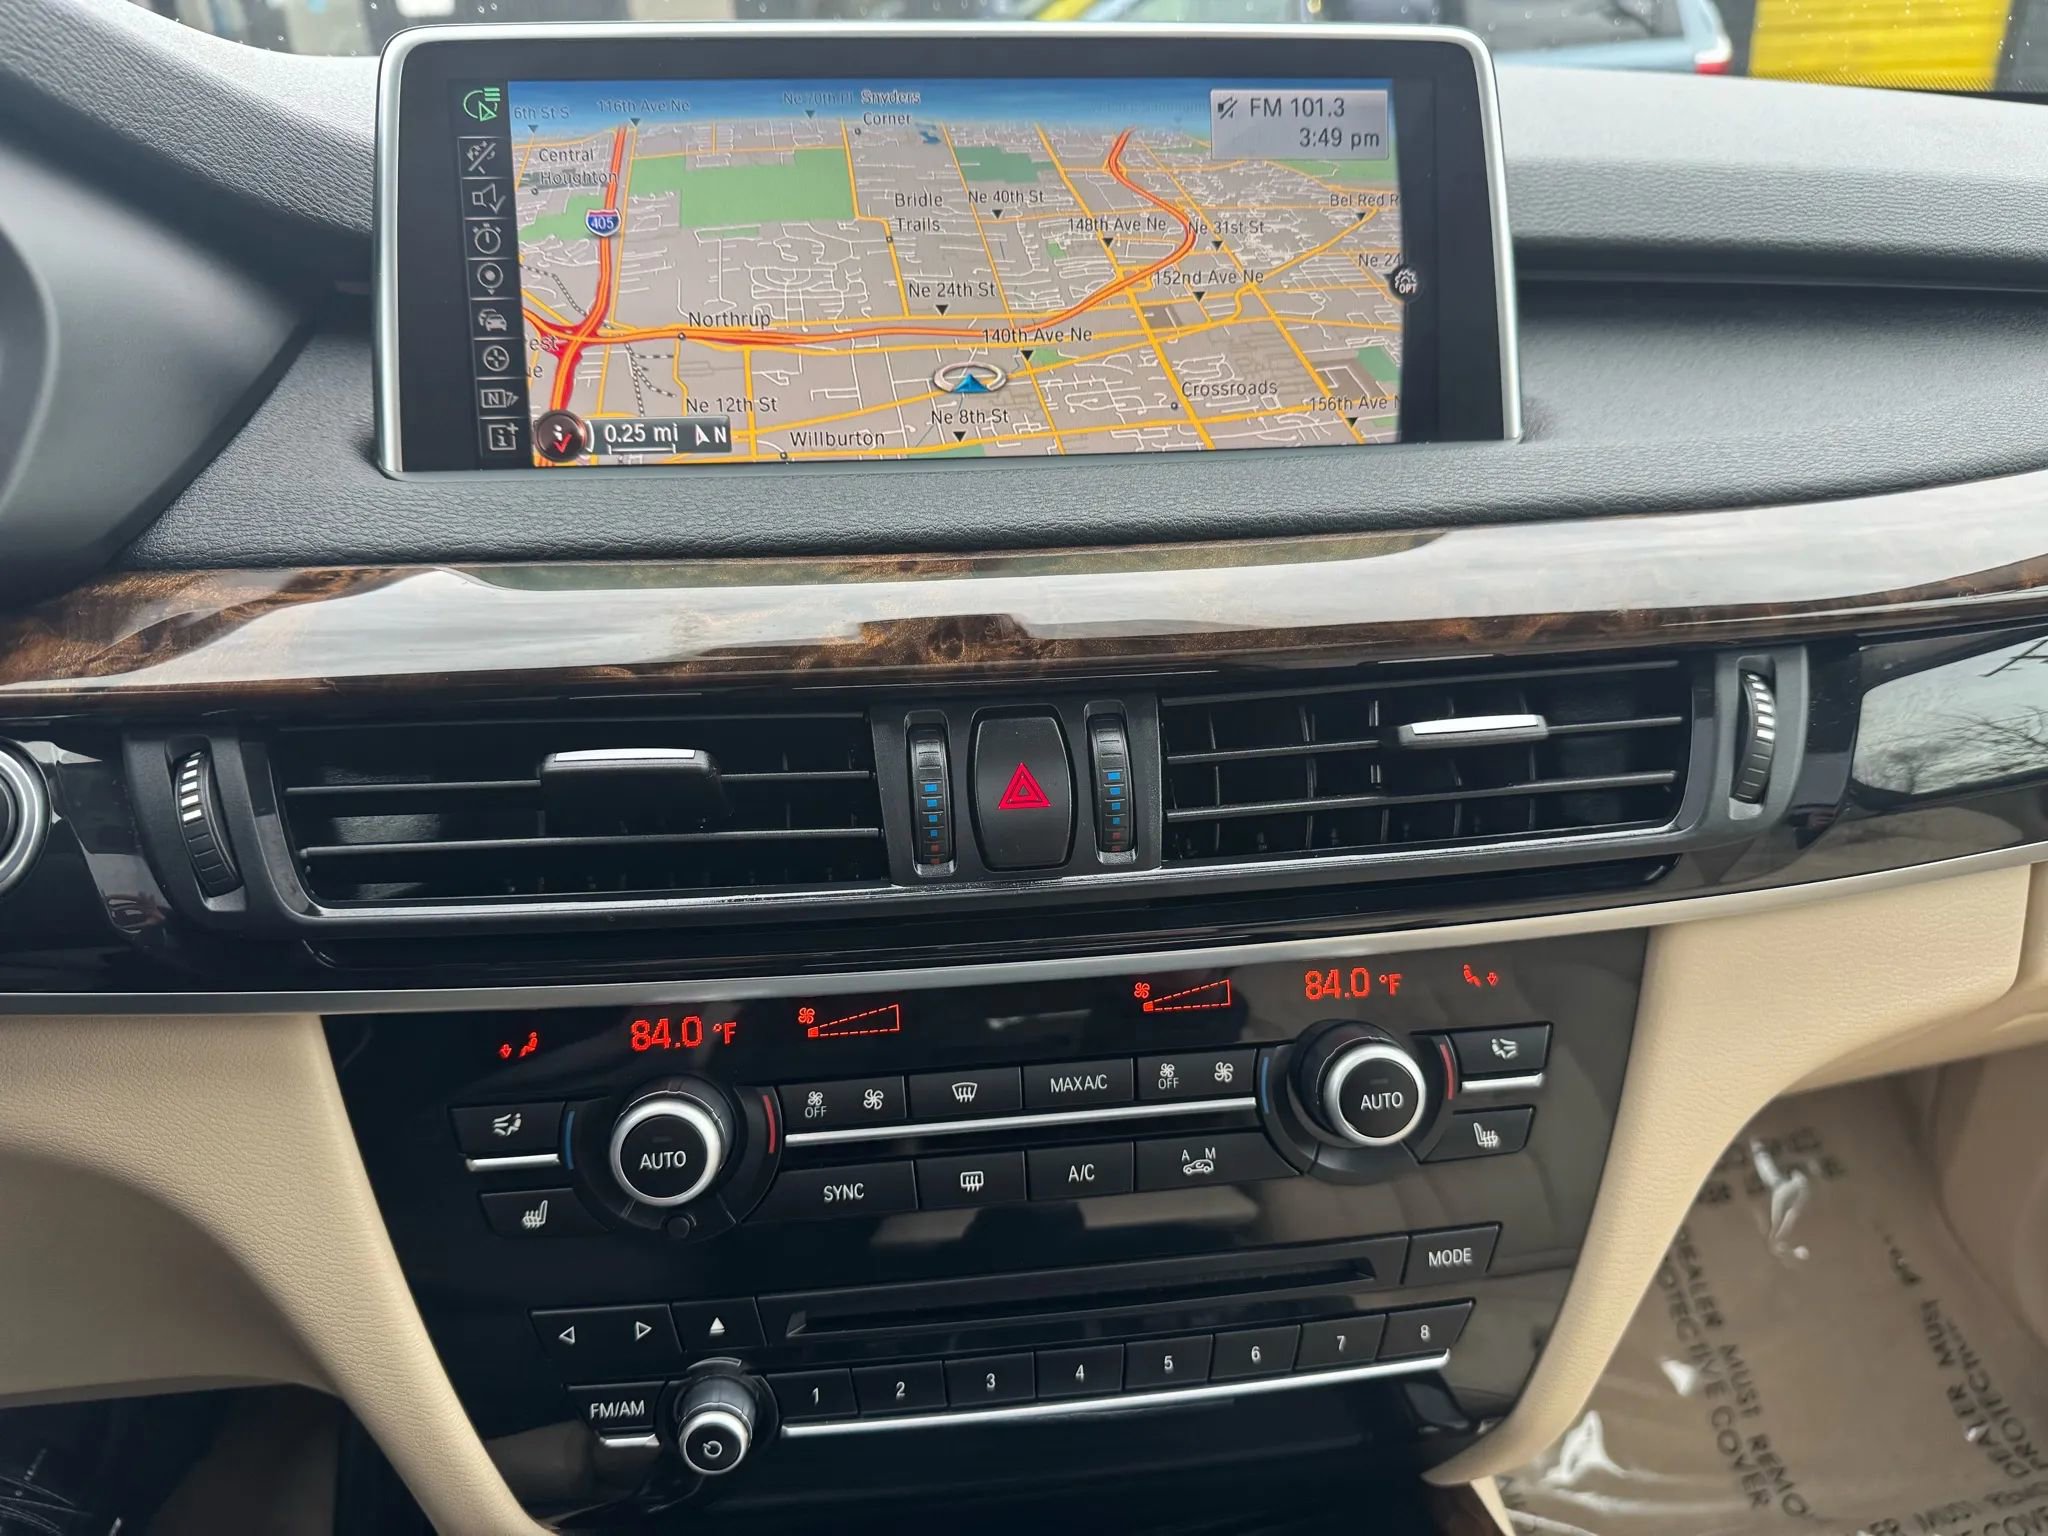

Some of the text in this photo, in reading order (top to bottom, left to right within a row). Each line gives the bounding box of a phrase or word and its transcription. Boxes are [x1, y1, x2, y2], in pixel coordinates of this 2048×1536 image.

[600, 99, 690, 113] 116th Ave Ne
[860, 88, 921, 107] Snyders
[514, 105, 570, 120] 6th St S
[1250, 97, 1345, 117] FM 101.3
[863, 112, 912, 126] Corner
[1299, 127, 1380, 151] 3:49 pm
[539, 148, 595, 163] Central
[540, 170, 619, 188] Houghton
[895, 193, 943, 208] Bridle
[968, 190, 1044, 204] Ne 40th St
[1330, 193, 1352, 207] Bel
[1358, 193, 1384, 207] Red
[591, 215, 614, 230] 405
[896, 217, 941, 233] Trails
[1068, 217, 1166, 232] 148th Ave Ne
[1188, 220, 1265, 235] Ne 31st St
[1358, 253, 1378, 267] Ne
[1155, 269, 1264, 285] 152nd Ave Ne
[908, 282, 996, 298] Ne 24th St
[1399, 283, 1418, 294] OPT
[688, 312, 771, 330] Northrup
[983, 327, 1092, 344] 140th Ave Ne
[1181, 379, 1278, 398] Crossroads
[686, 397, 778, 413] Ne 12th St
[1311, 397, 1352, 412] 156th
[1358, 395, 1387, 410] Ave
[931, 409, 1009, 425] Ne 8th St
[604, 420, 728, 444] 0.25 mi N
[790, 430, 886, 447] Willburton
[1305, 967, 1371, 1000] 84.0
[631, 1016, 703, 1051] 84.0
[1158, 1078, 1180, 1090] OFF
[1360, 1091, 1403, 1111] AUTO
[804, 1105, 827, 1118] OFF
[639, 1150, 687, 1171] AUTO
[1068, 1163, 1095, 1182] A/C
[823, 1182, 865, 1202] SYNC
[1428, 1247, 1472, 1267] MODE
[812, 1324, 1431, 1405] 1 2 3 4 5 6 7 8
[590, 1399, 645, 1420] FM/AM
[1718, 1343, 1763, 1419] MUST
[1746, 1433, 1817, 1519] REMO
[1709, 1404, 1772, 1509] COVER
